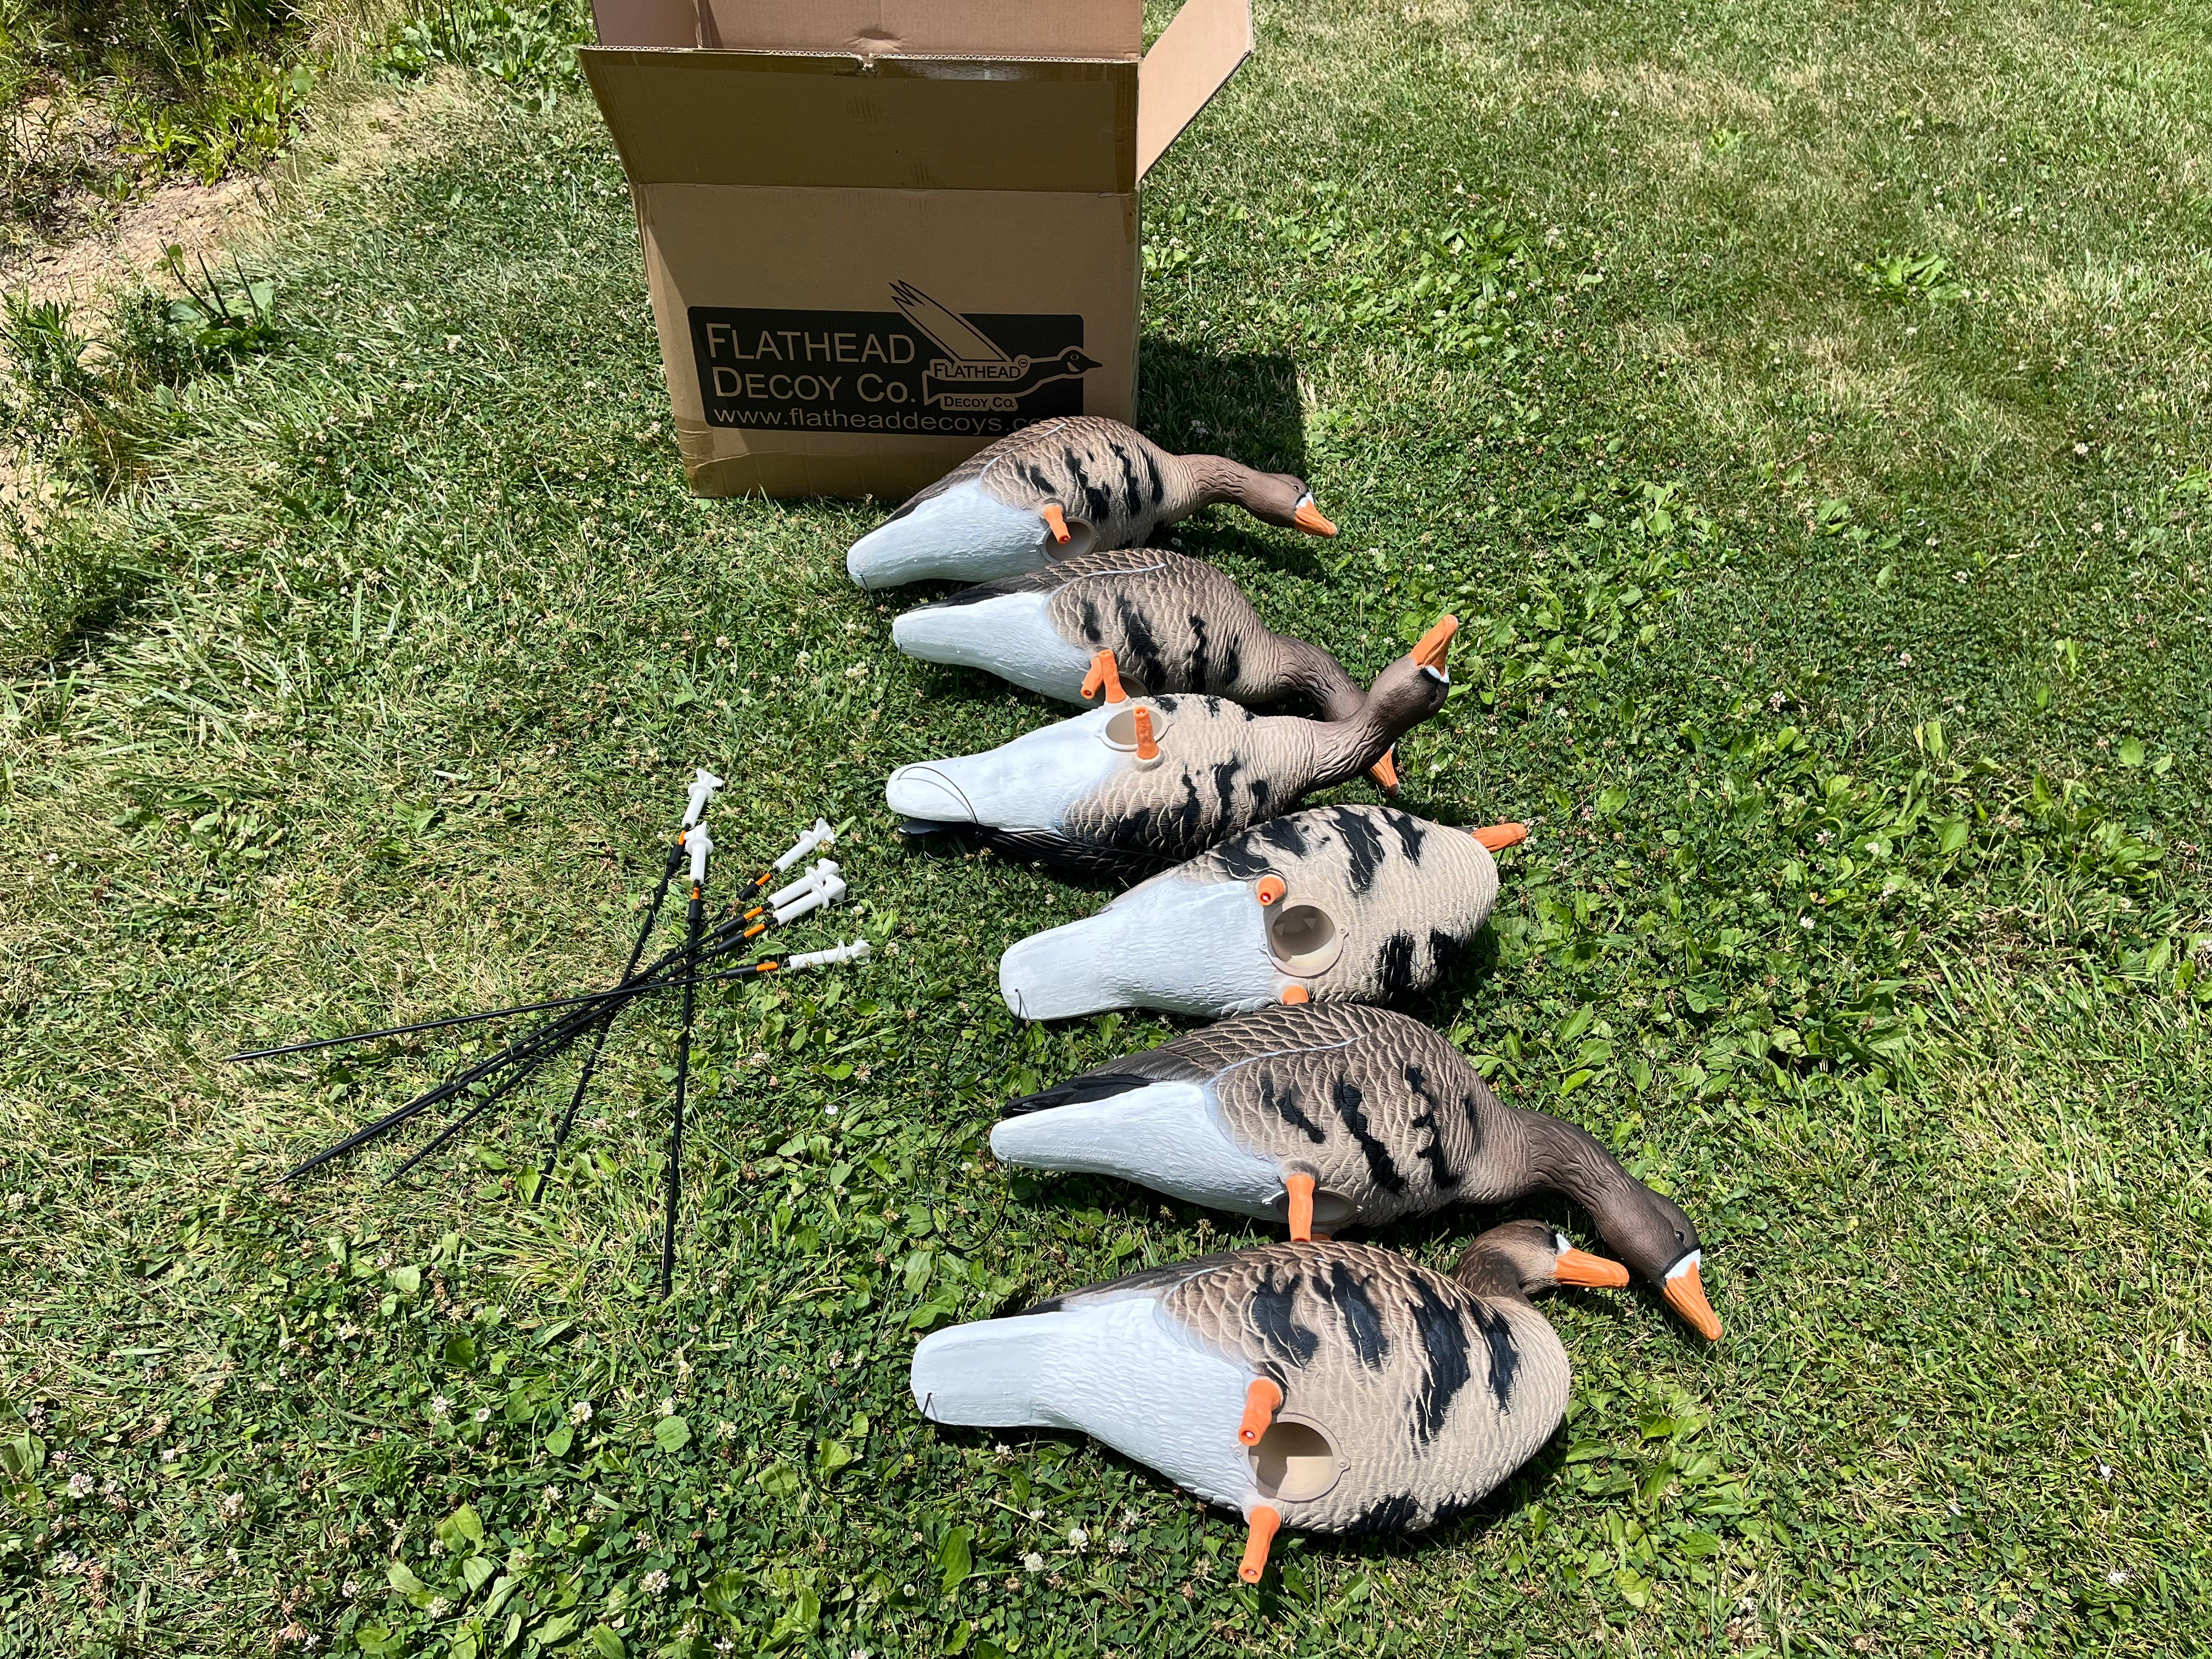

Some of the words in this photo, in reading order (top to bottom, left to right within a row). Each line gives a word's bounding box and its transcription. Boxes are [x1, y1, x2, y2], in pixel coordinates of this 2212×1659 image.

[706, 323, 915, 364] FLATHEAD
[712, 366, 843, 401] DECOY
[933, 362, 1021, 379] FLATHEAD
[944, 396, 988, 408] DECOY
